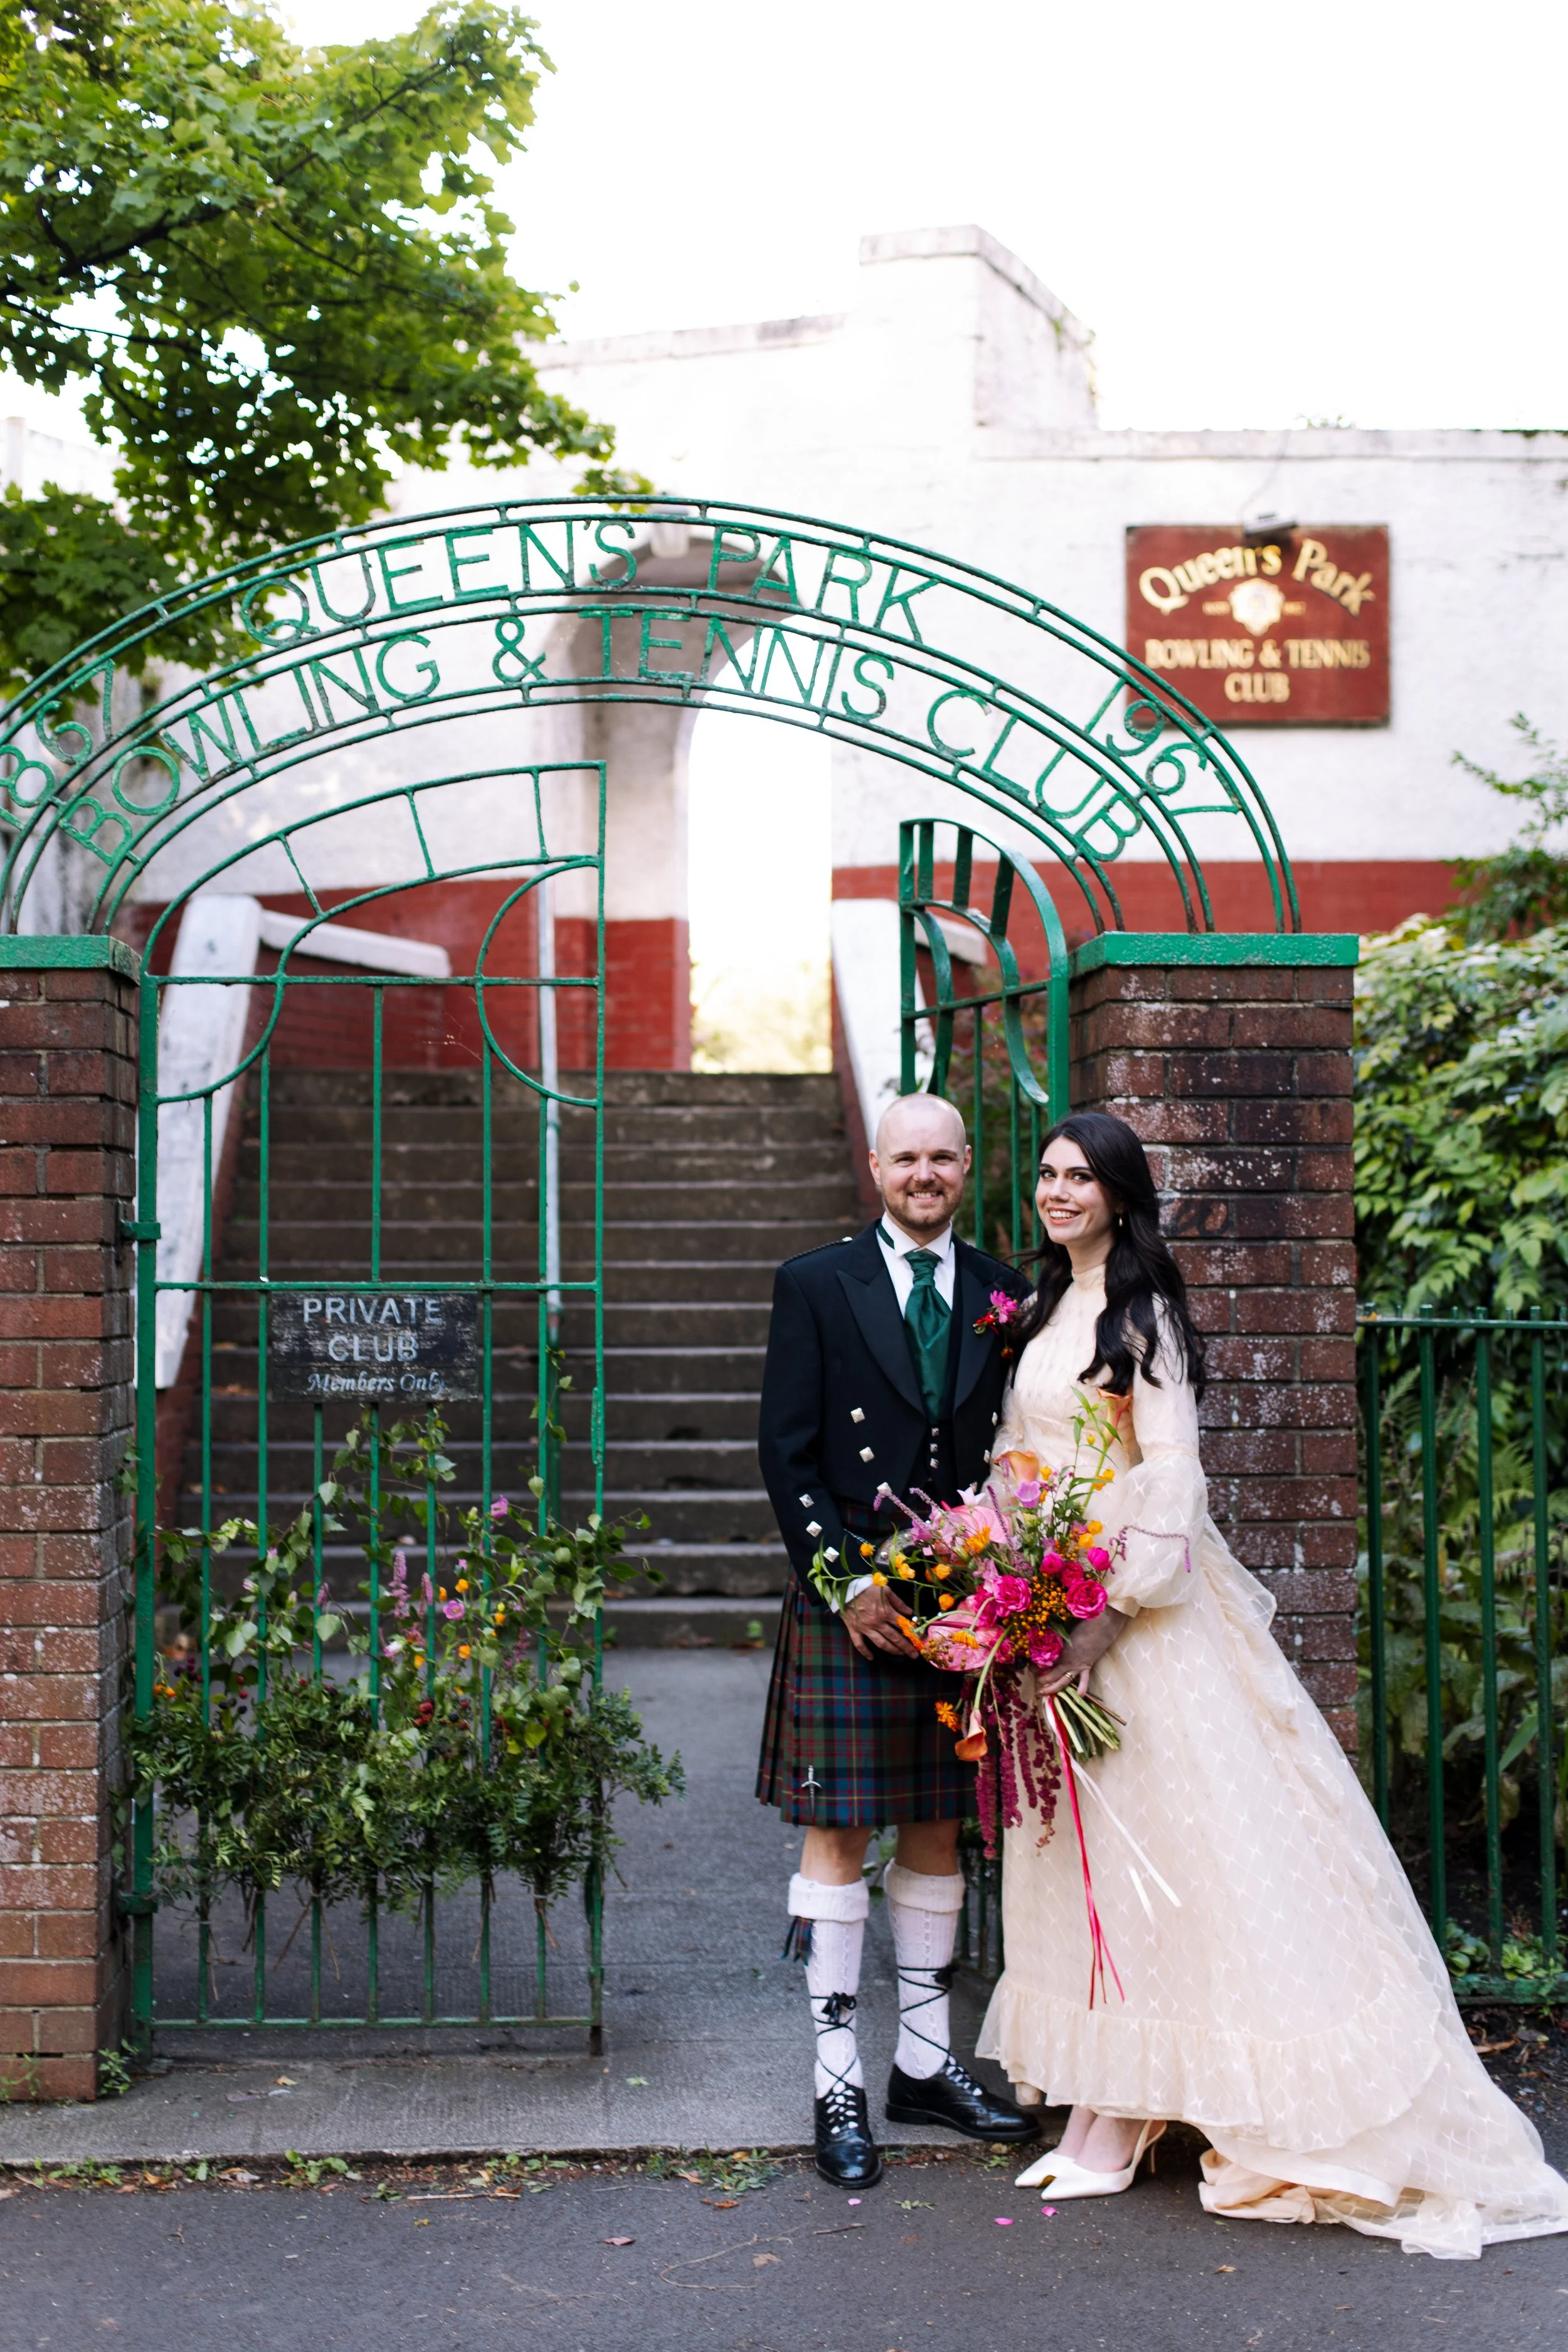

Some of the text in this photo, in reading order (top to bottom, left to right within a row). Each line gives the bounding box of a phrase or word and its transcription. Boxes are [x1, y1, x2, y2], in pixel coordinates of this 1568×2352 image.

[1139, 538, 1376, 618] Queen's Park
[241, 518, 637, 649] QUEEN'S
[706, 525, 940, 644] PARK
[1084, 677, 1241, 815] 1967
[1145, 639, 1371, 669] BOWLING & TENNIS
[1224, 672, 1291, 703] CLUB
[60, 608, 1143, 867] BOWLING & TENNIS CLUB
[303, 1297, 444, 1324] PRIVATE
[328, 1335, 418, 1362] CLUB
[307, 1371, 445, 1399] Members Only
